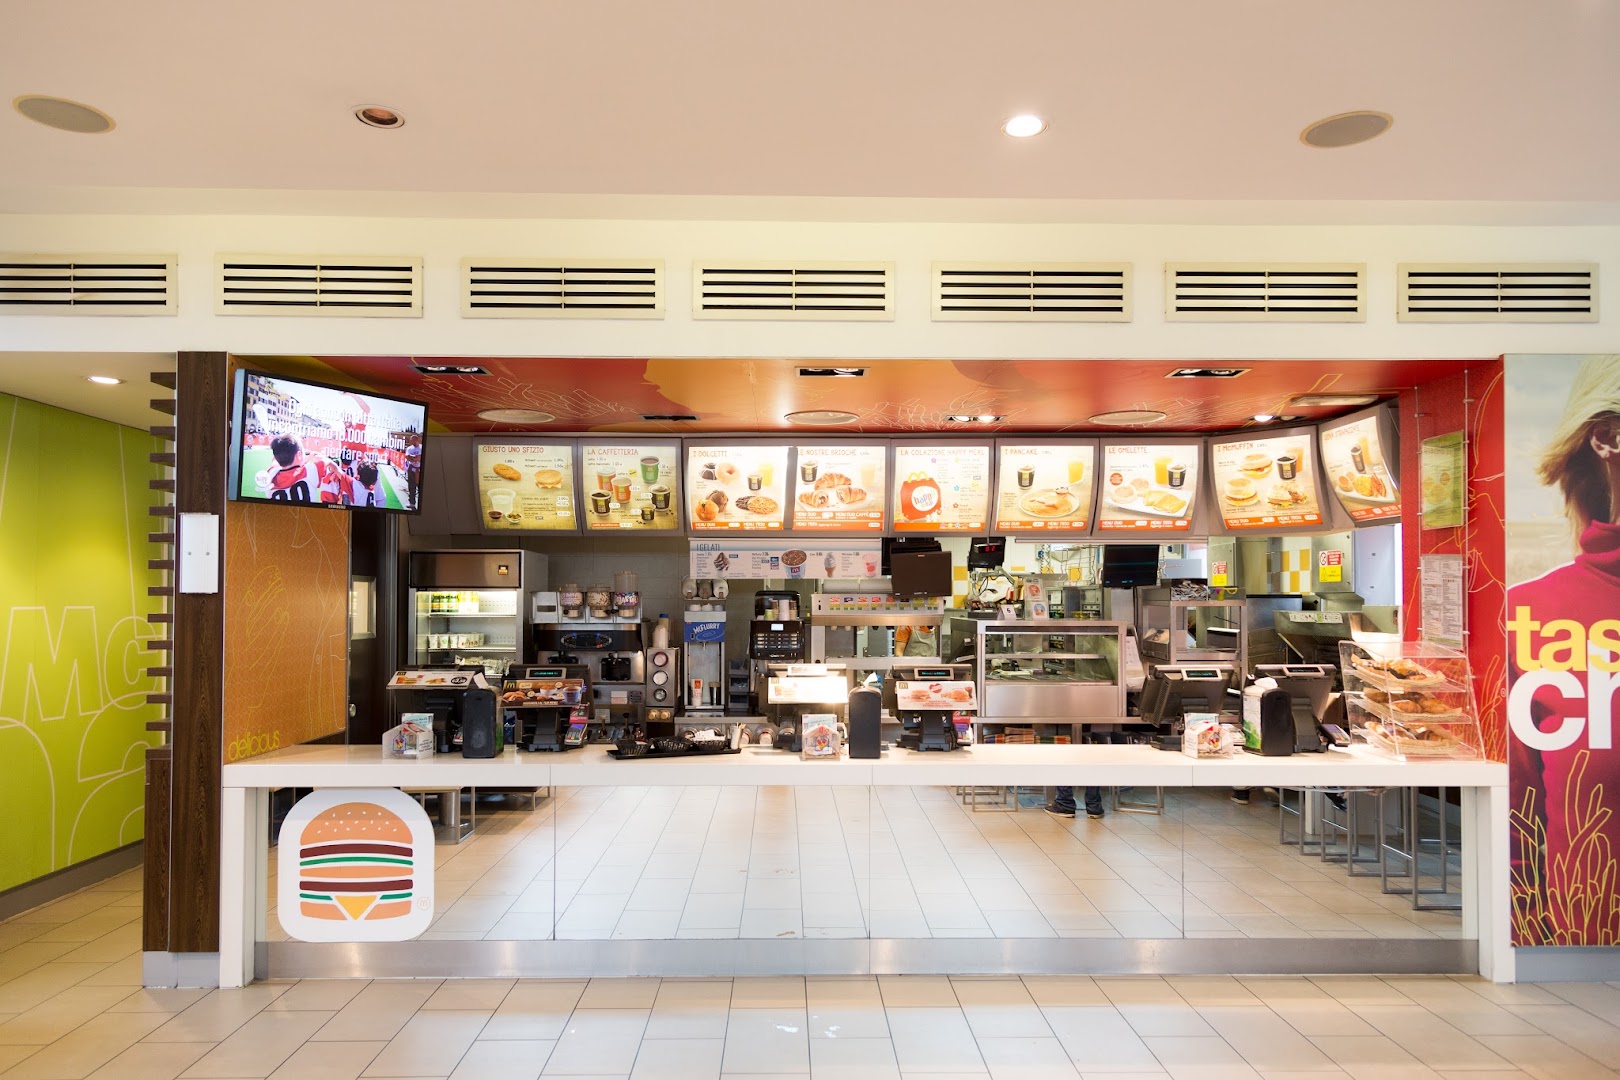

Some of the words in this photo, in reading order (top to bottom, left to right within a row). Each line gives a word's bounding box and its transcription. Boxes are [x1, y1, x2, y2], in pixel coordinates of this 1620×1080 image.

[368, 429, 406, 450] bambini
[522, 446, 544, 454] SFIZIO
[587, 448, 596, 456] LA
[597, 448, 639, 456] CAFFETTERIA
[363, 451, 389, 465] sport
[699, 543, 721, 552] GELATI
[1507, 606, 1620, 673] tas
[228, 729, 280, 761] delicious
